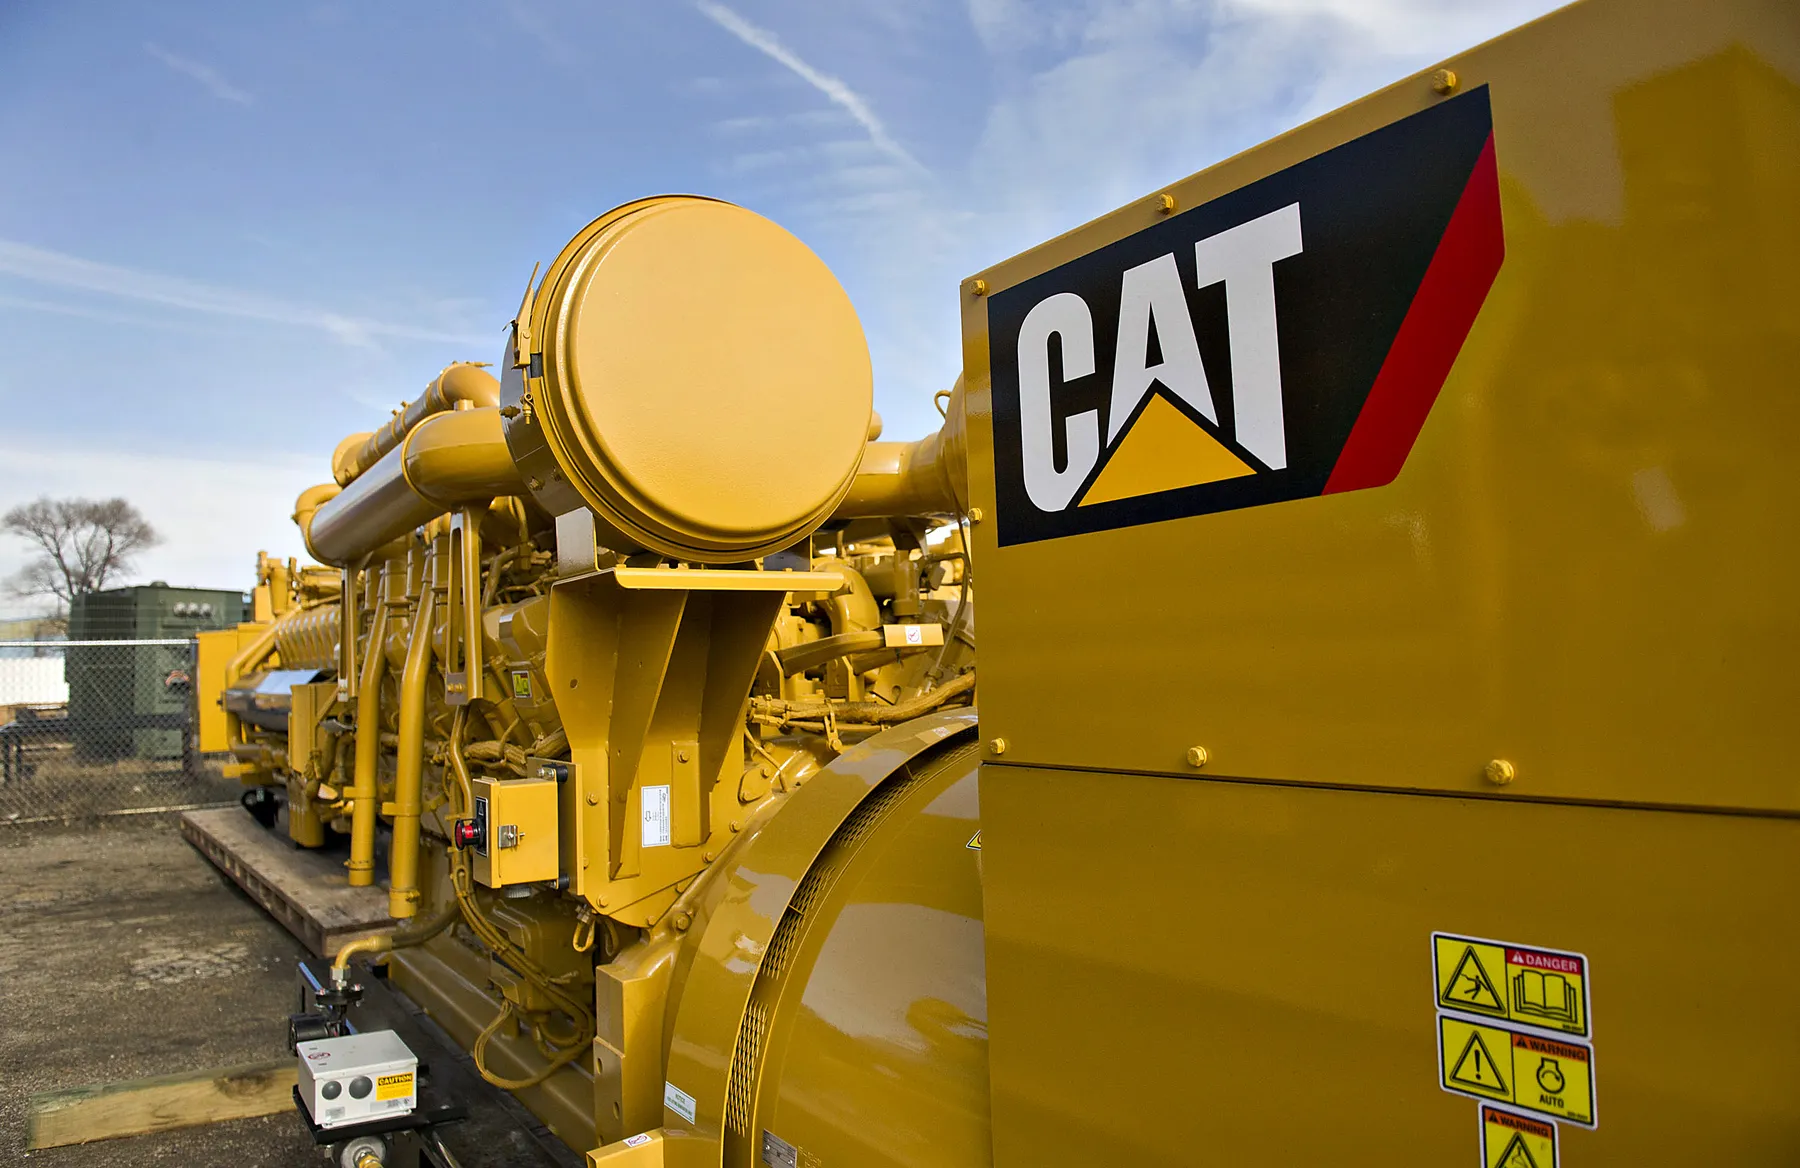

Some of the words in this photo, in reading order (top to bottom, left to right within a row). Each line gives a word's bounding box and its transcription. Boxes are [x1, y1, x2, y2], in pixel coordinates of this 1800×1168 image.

[1017, 202, 1303, 512] CAT
[1525, 954, 1578, 972] DANGER
[1529, 1040, 1585, 1061] WARNING
[379, 1074, 412, 1085] CAUTION
[1539, 1094, 1565, 1108] AUTO
[1500, 1115, 1549, 1137] WARNING
